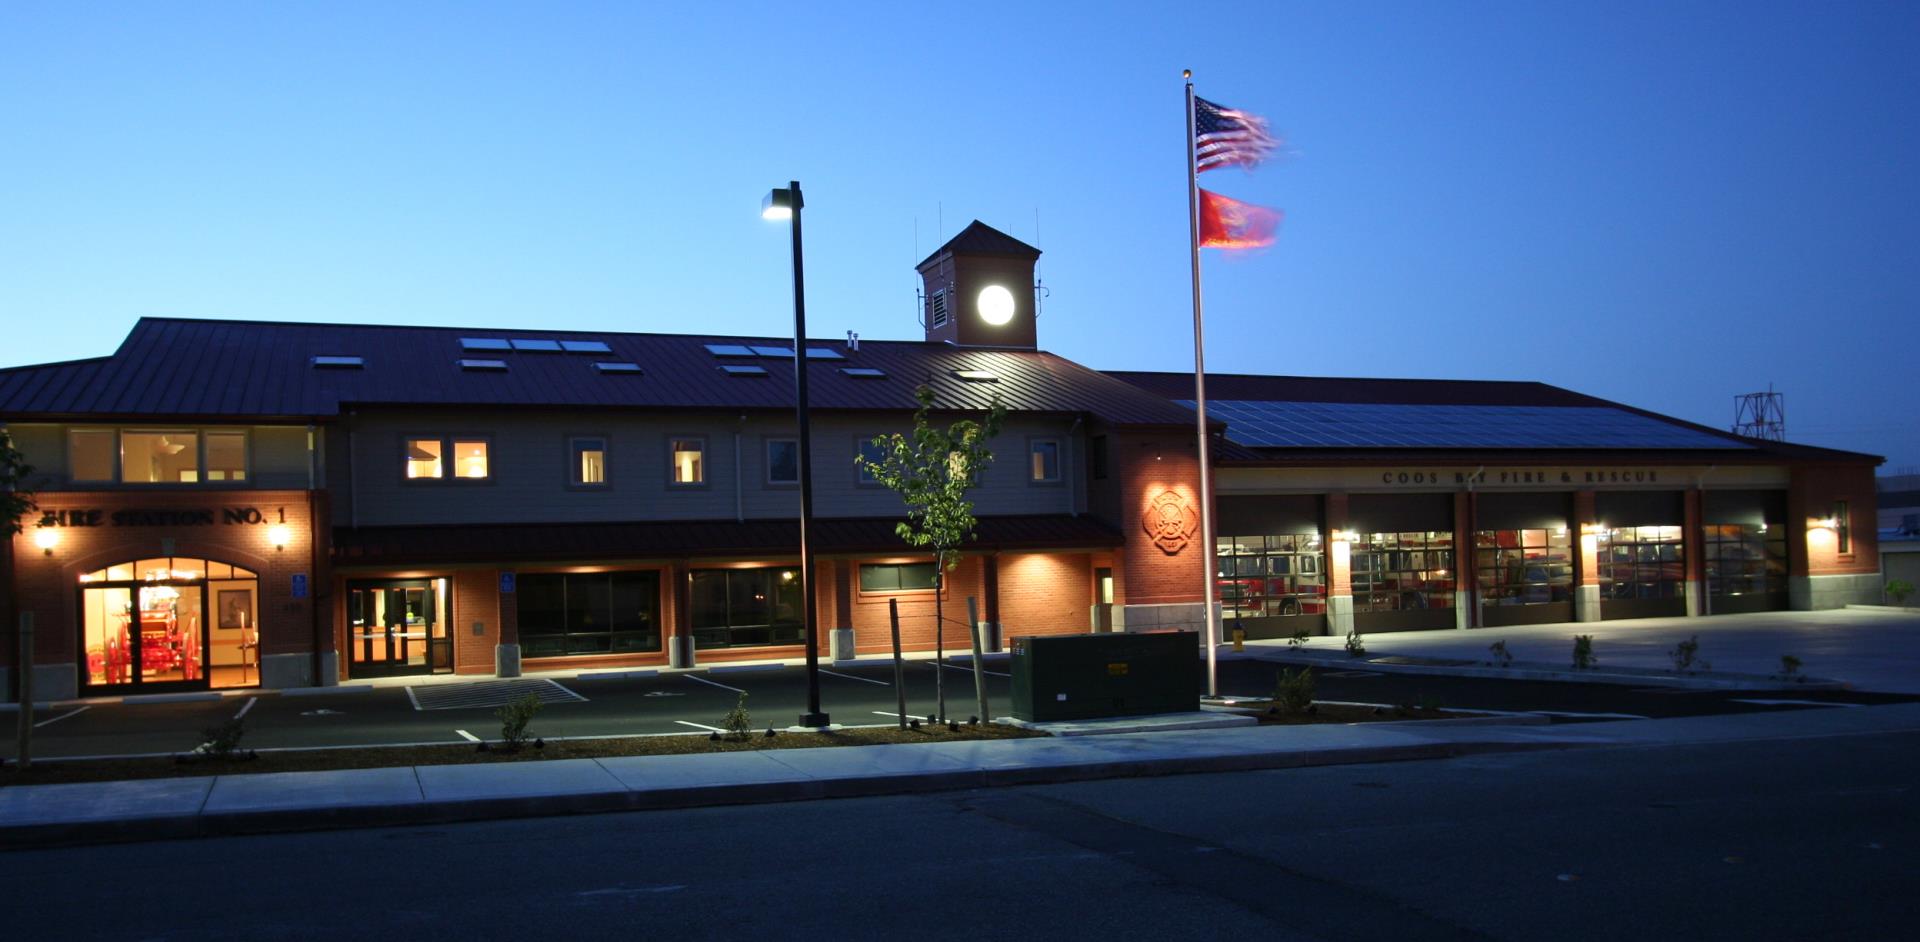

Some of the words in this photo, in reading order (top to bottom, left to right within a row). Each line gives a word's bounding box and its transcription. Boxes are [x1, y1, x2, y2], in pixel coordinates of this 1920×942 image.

[1383, 472, 1437, 483] COOS
[1501, 472, 1544, 482] FIRE
[1561, 471, 1570, 482] &
[1585, 471, 1657, 482] RESCUE
[112, 508, 214, 526] STATION
[223, 507, 267, 524] NO.
[278, 507, 287, 524] 1
